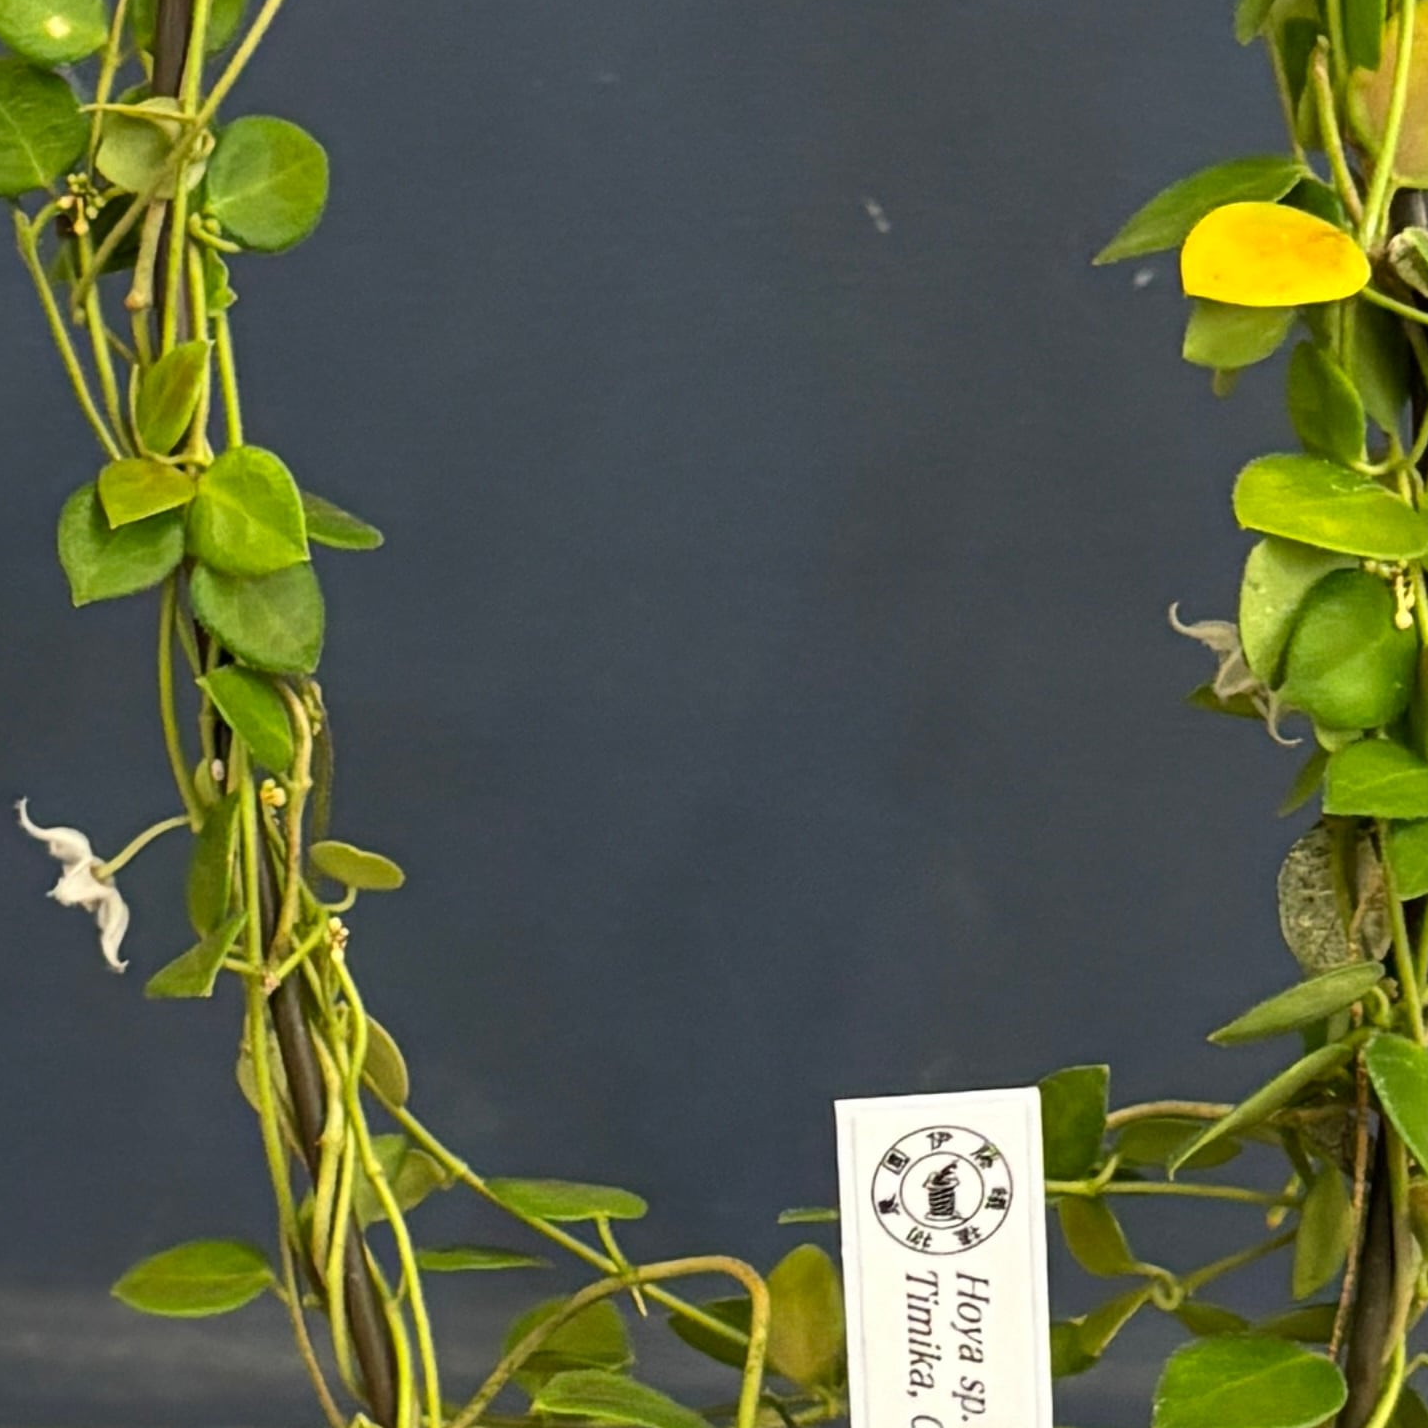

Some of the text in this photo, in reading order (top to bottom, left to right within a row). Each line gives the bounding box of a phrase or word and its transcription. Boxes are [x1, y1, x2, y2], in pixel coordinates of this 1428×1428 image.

[905, 1270, 943, 1398] Timika,
[950, 1271, 991, 1422] Hoya sp.
